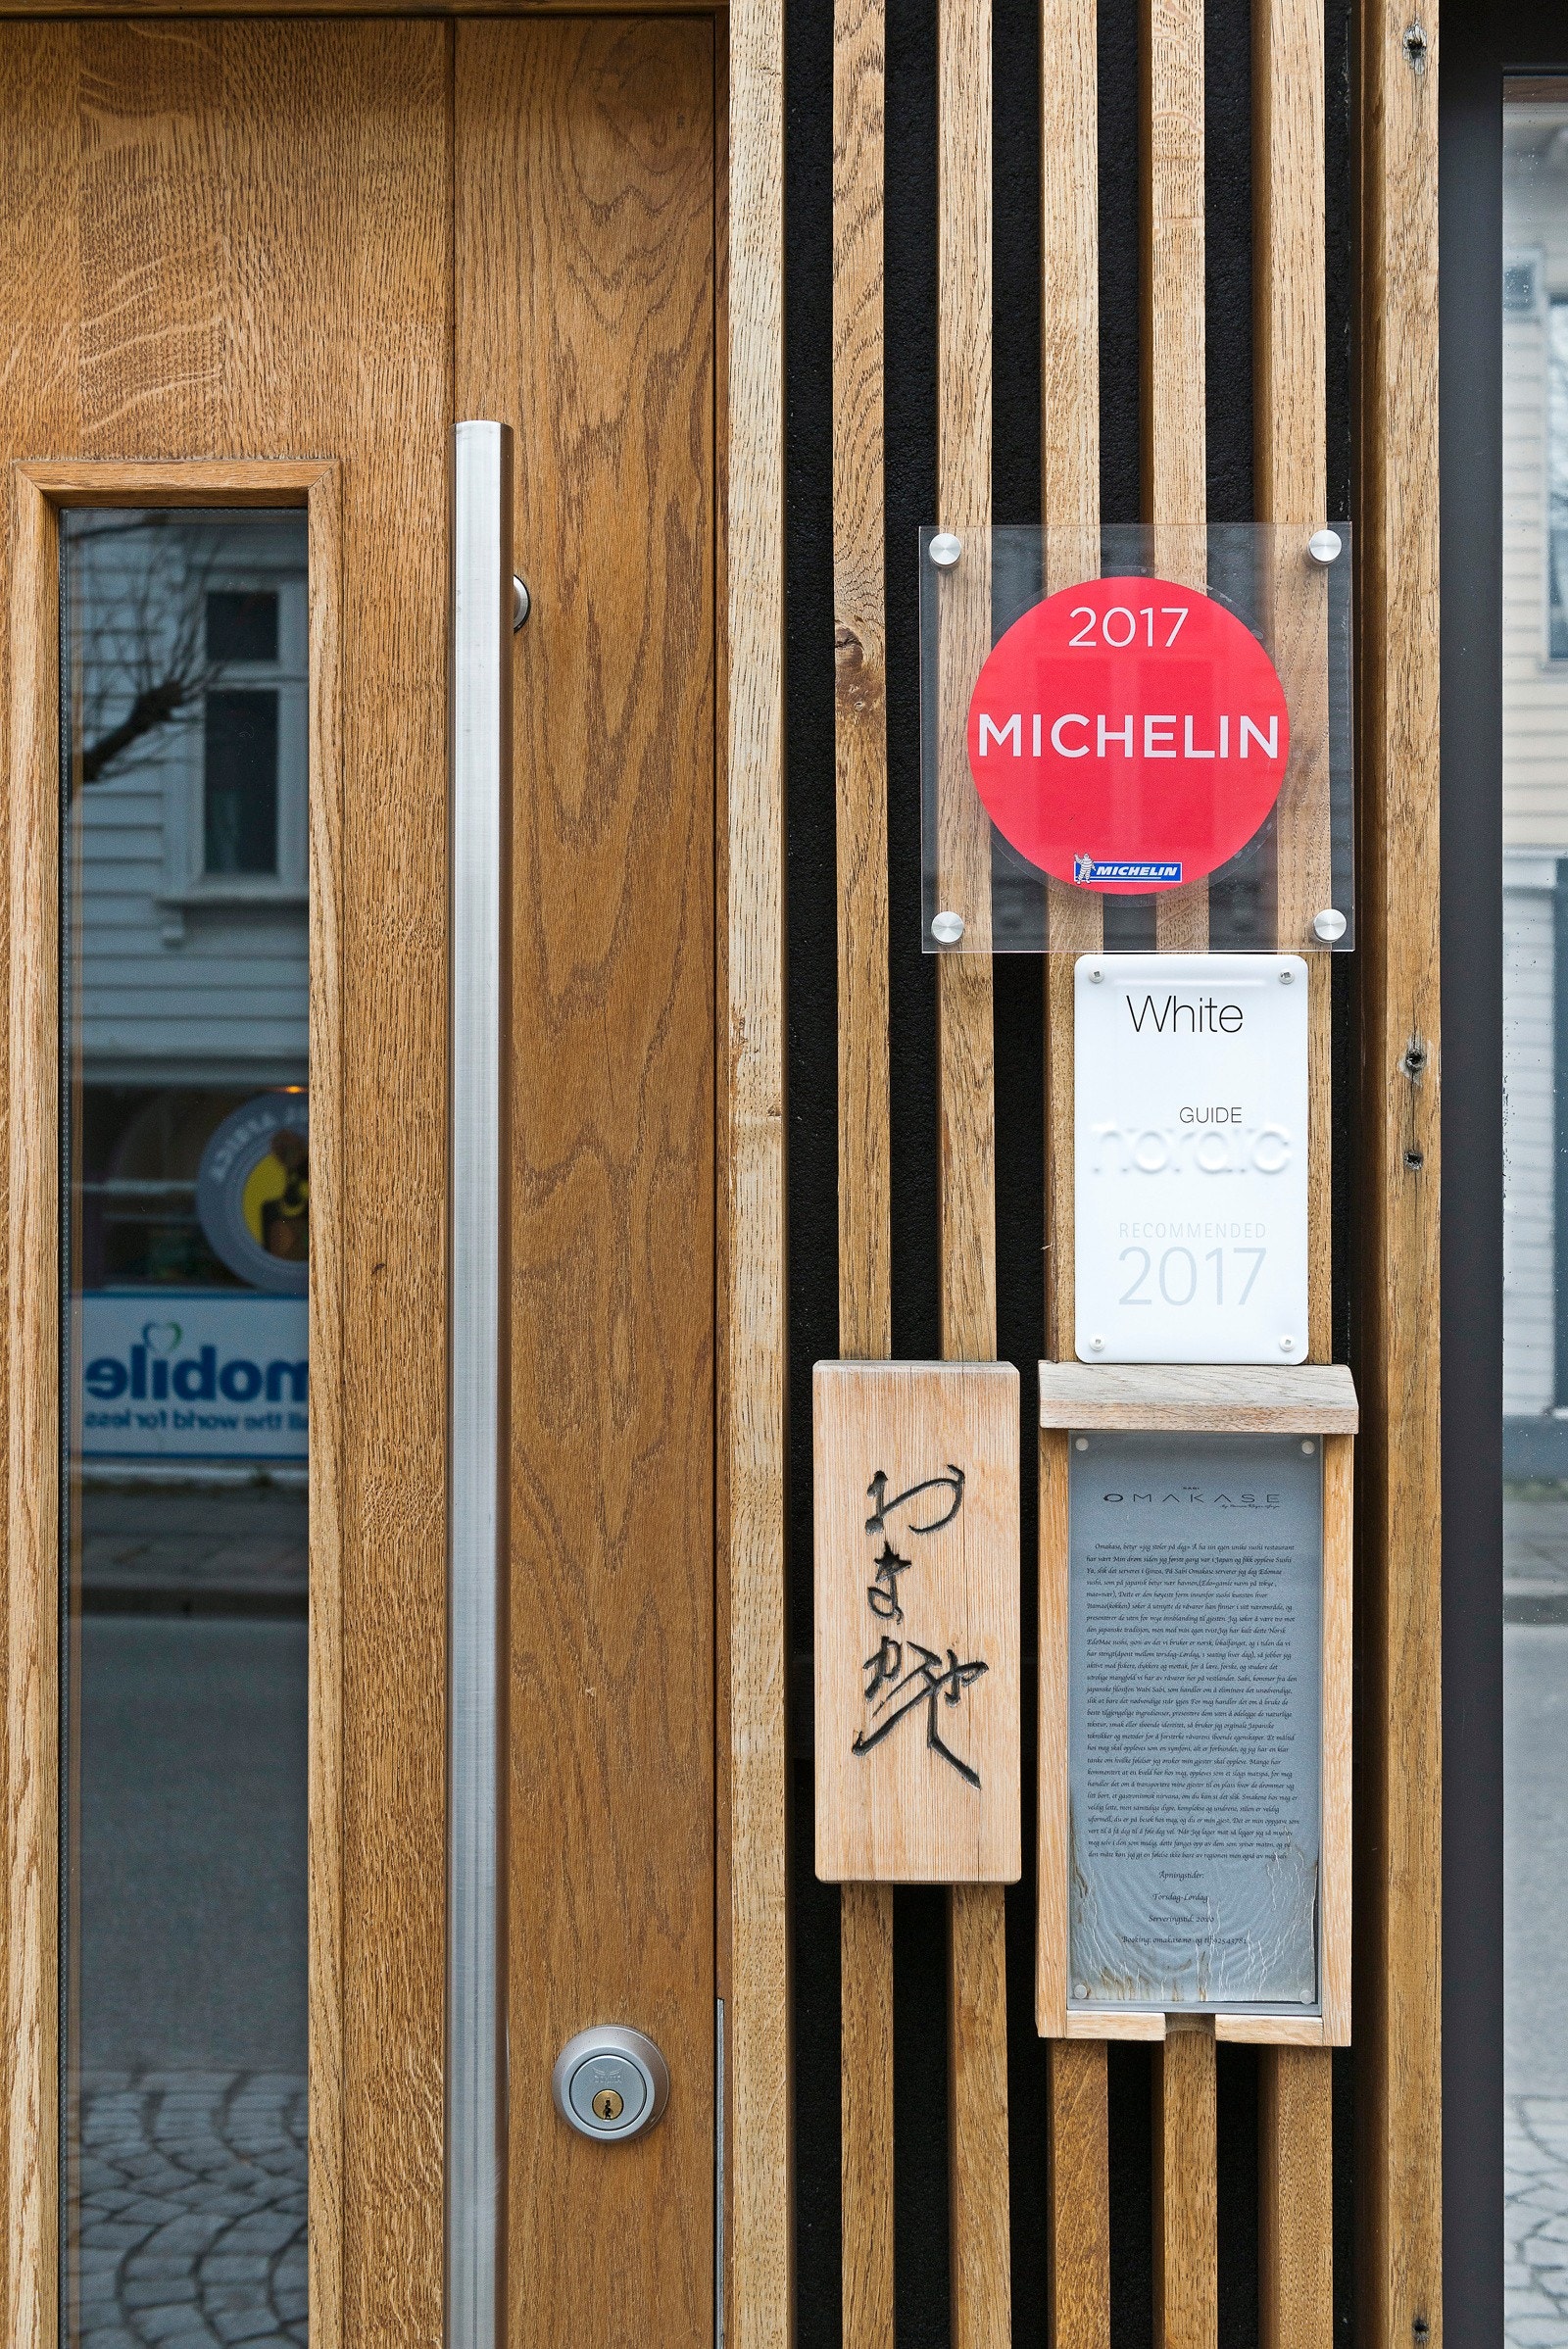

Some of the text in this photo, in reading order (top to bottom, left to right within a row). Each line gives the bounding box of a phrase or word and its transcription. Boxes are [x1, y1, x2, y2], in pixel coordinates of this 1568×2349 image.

[1068, 607, 1189, 648] 2017
[978, 712, 1279, 759] MICHELIN
[1096, 865, 1178, 877] MICHELIN
[1126, 995, 1244, 1034] White
[1179, 1106, 1243, 1124] GUIDE
[1119, 1222, 1266, 1239] RECOMMENDED
[1118, 1246, 1267, 1307] 2017
[1102, 1493, 1280, 1503] OMAKASE
[1158, 1870, 1204, 1882] Åpningstider:
